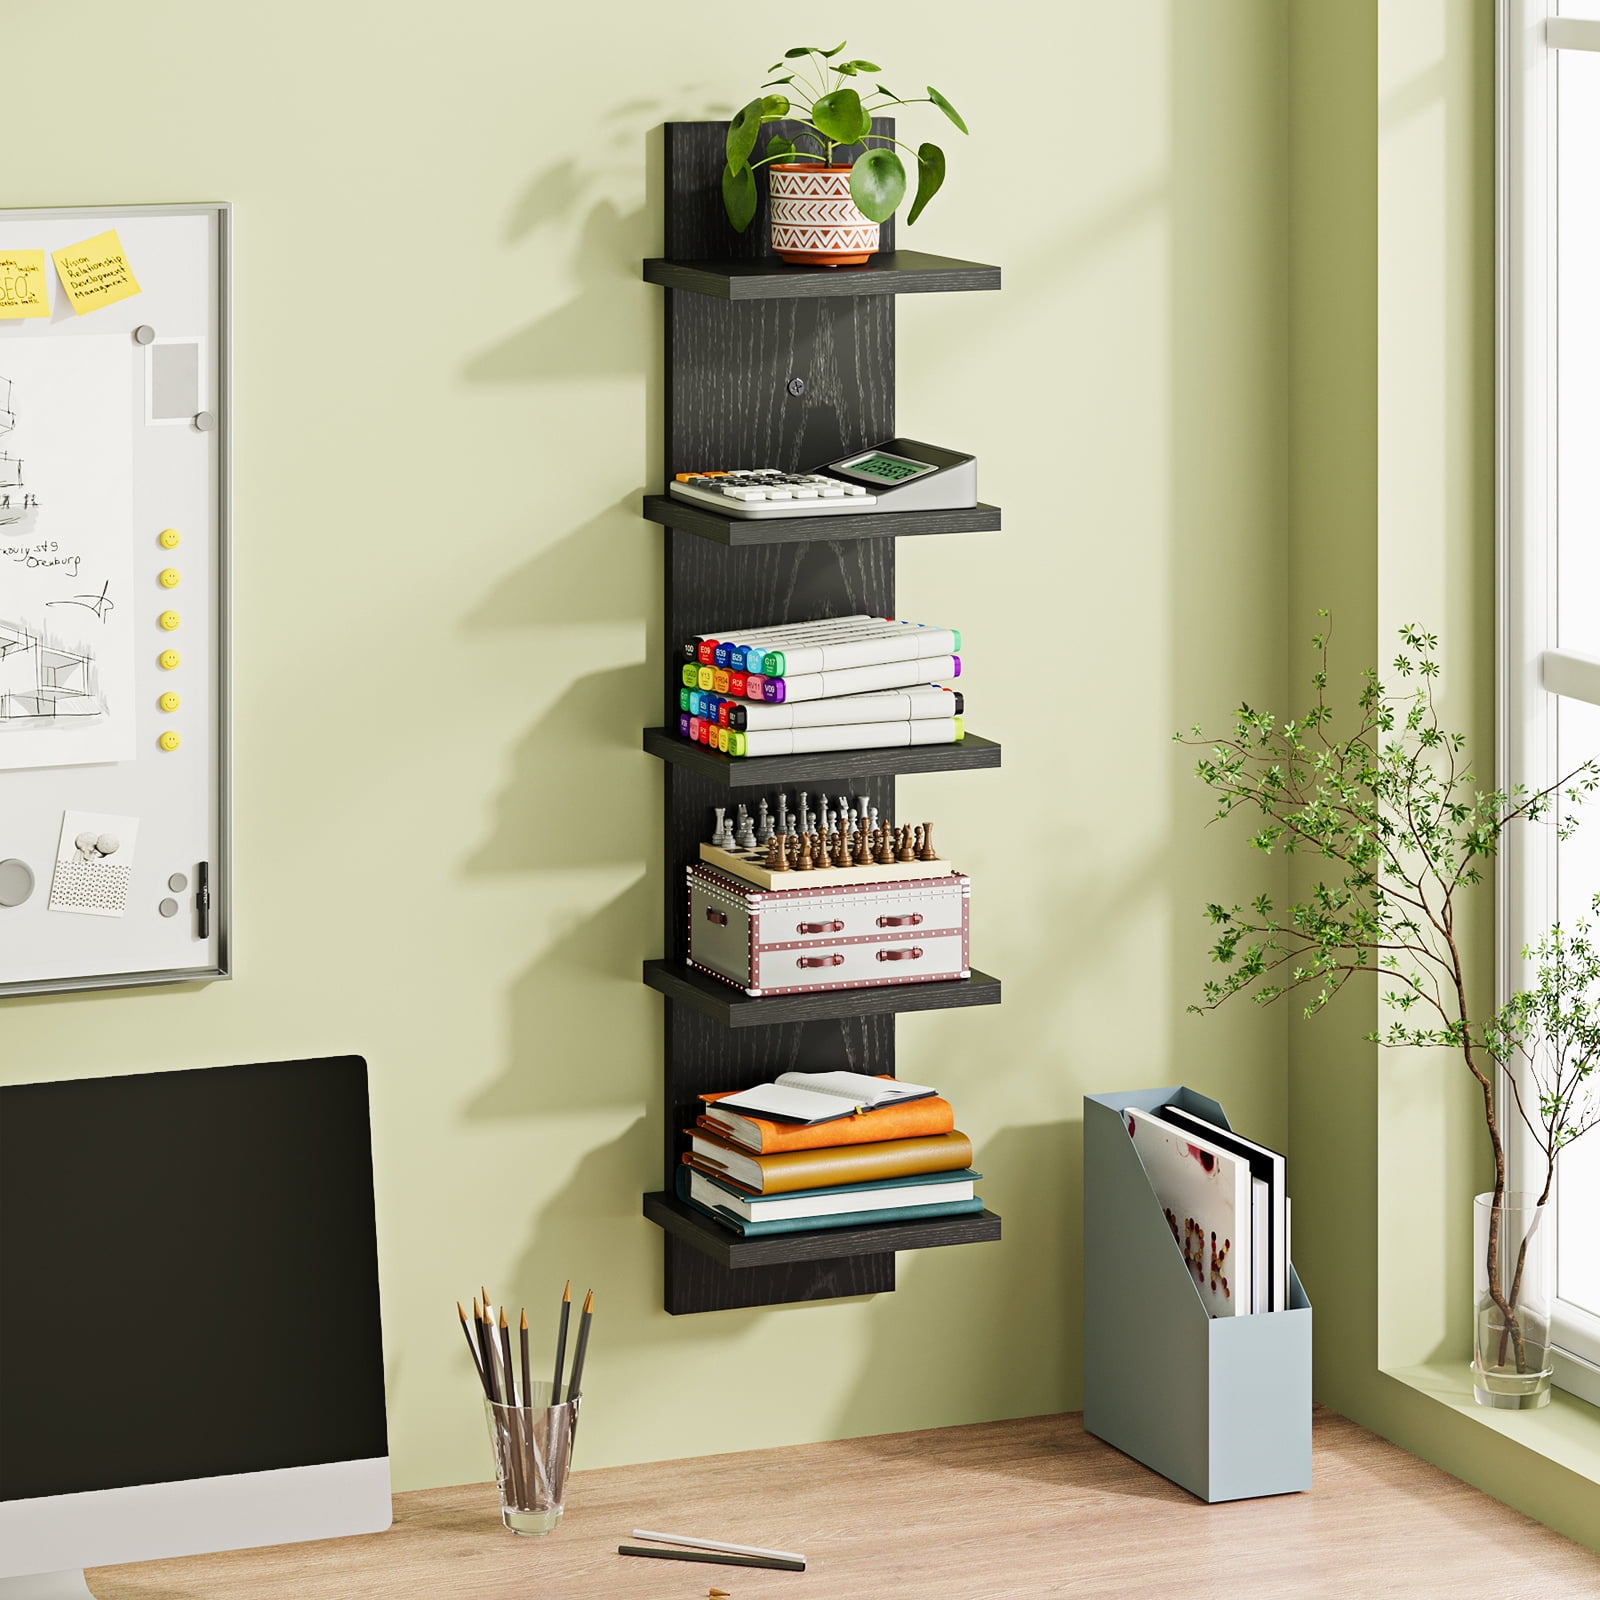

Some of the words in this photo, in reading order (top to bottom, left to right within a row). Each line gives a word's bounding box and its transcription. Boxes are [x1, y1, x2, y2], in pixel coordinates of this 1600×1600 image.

[60, 257, 90, 269] Vision
[67, 256, 123, 278] Relationship
[70, 264, 126, 290] Development
